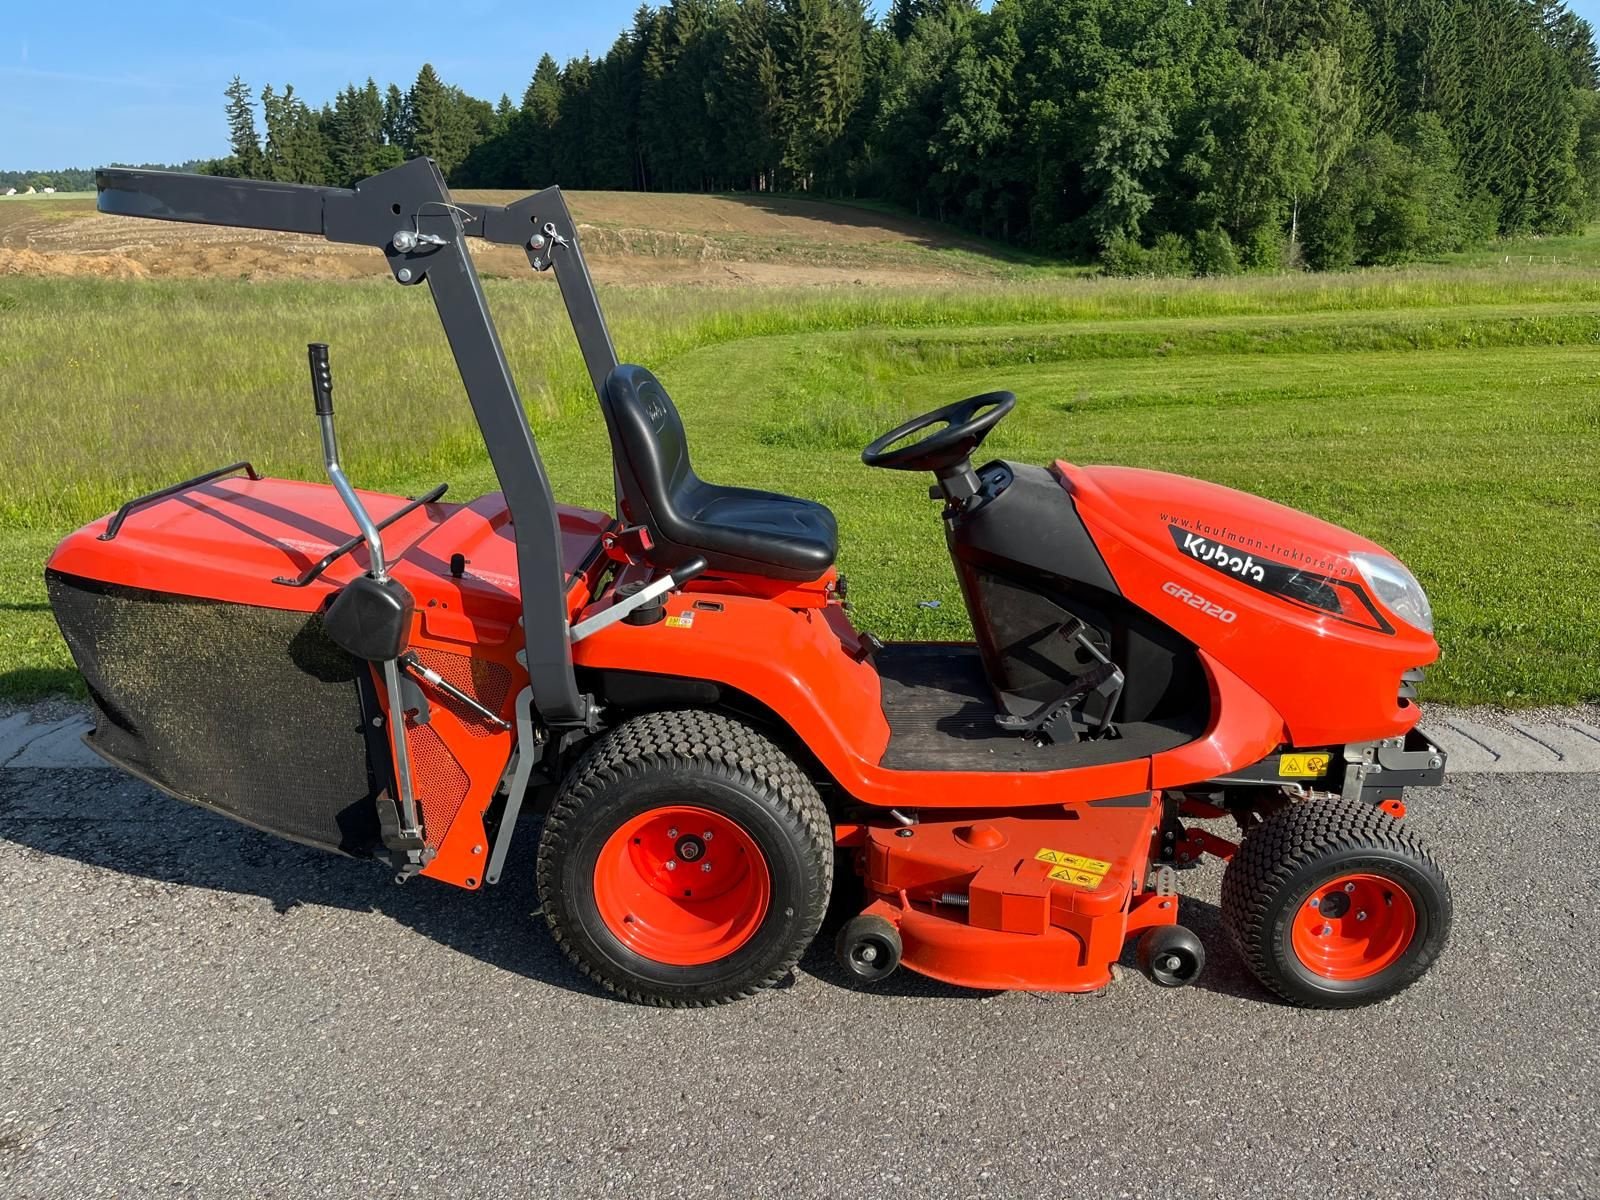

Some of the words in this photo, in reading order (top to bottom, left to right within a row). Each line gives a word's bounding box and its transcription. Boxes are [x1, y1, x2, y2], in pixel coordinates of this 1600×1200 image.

[1160, 512, 1354, 577] www.kaufmann-traktoren.at
[1183, 533, 1265, 582] Kubota
[1162, 581, 1237, 623] GR2120
